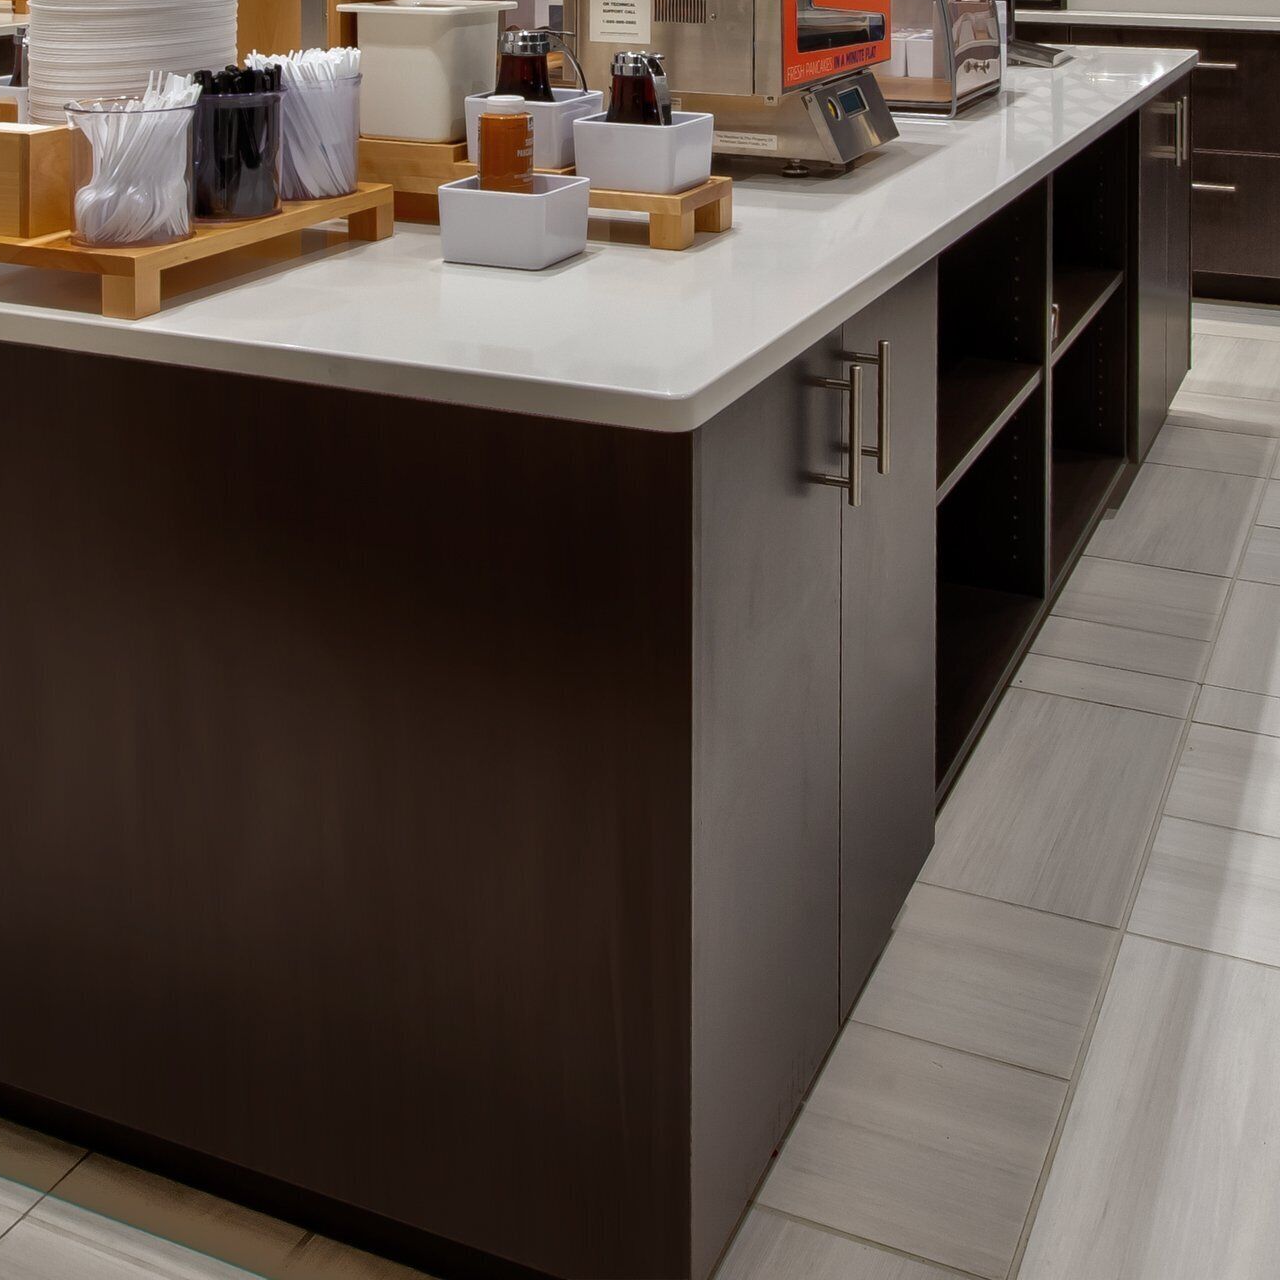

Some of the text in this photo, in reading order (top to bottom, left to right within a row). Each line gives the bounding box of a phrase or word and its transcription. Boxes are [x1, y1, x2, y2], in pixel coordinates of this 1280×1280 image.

[786, 64, 805, 81] FRESH
[805, 57, 833, 76] PANCAKES
[845, 49, 865, 65] MINUTE
